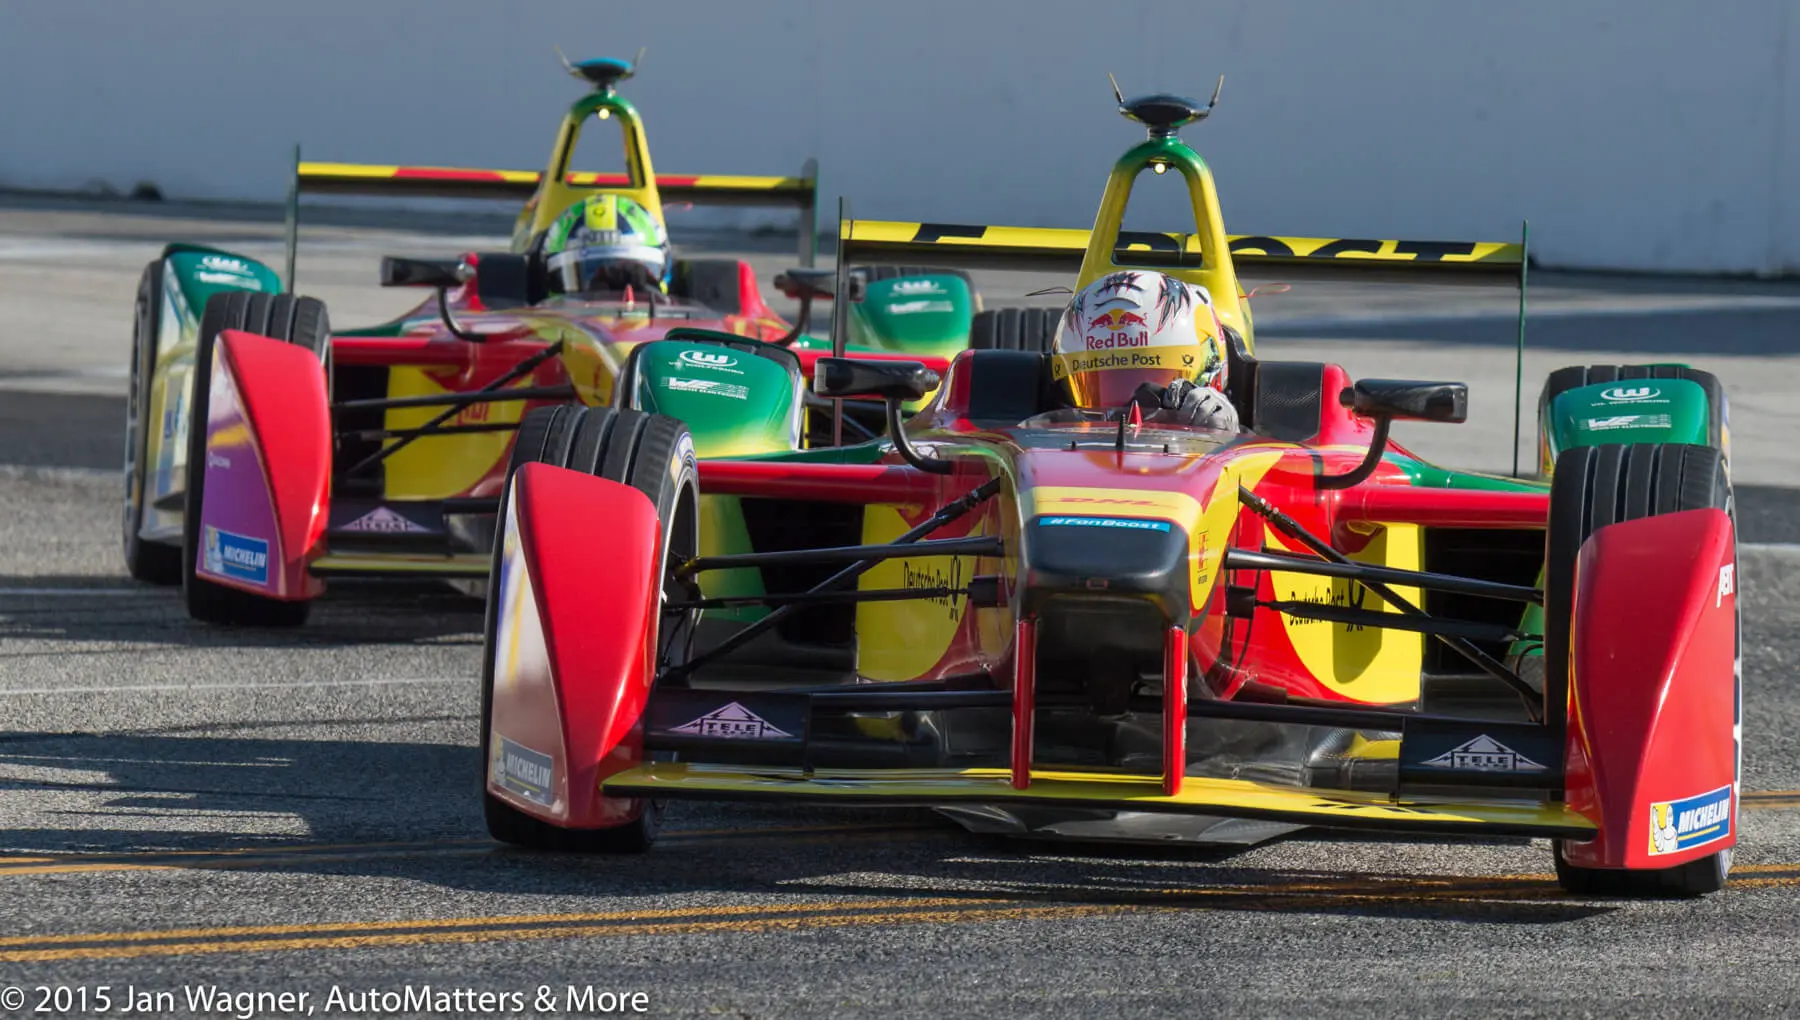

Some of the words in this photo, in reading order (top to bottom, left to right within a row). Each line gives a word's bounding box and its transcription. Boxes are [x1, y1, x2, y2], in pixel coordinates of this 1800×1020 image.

[1086, 333, 1115, 350] Red
[1118, 332, 1149, 348] Bull
[1072, 354, 1129, 371] Deutsche
[1131, 354, 1161, 366] Post
[1049, 518, 1162, 530] #FanBoost
[224, 545, 267, 569] MICHELIN
[706, 721, 757, 732] TELE
[1456, 755, 1509, 764] TELE
[506, 752, 551, 789] MICHELIN
[1677, 798, 1730, 834] MICHELIN
